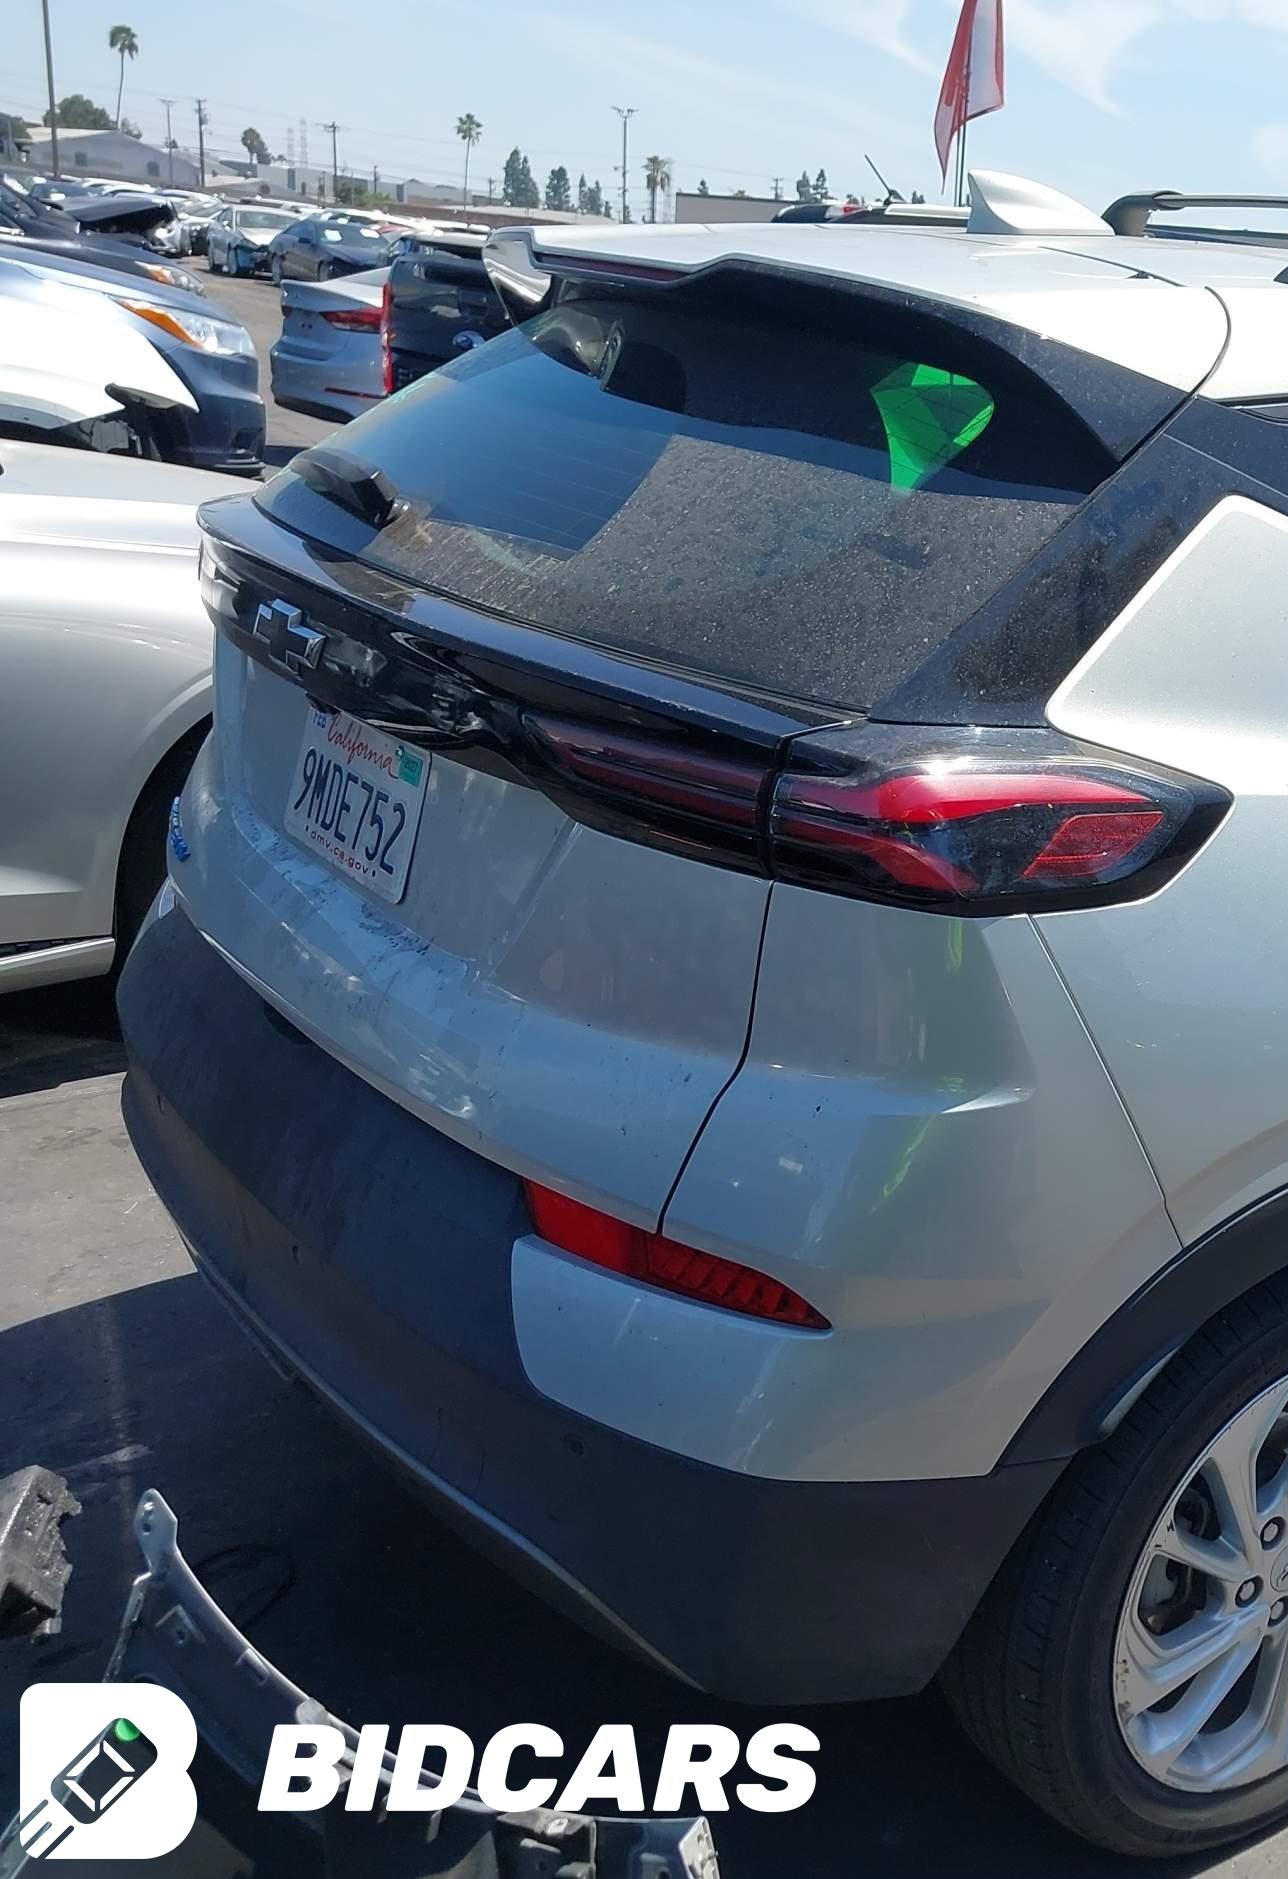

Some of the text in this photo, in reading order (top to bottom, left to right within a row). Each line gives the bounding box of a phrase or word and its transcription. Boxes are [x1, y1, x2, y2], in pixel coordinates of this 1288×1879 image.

[327, 711, 399, 779] California
[293, 747, 406, 876] 9MDE752
[310, 830, 369, 875] dmv.ca.gov
